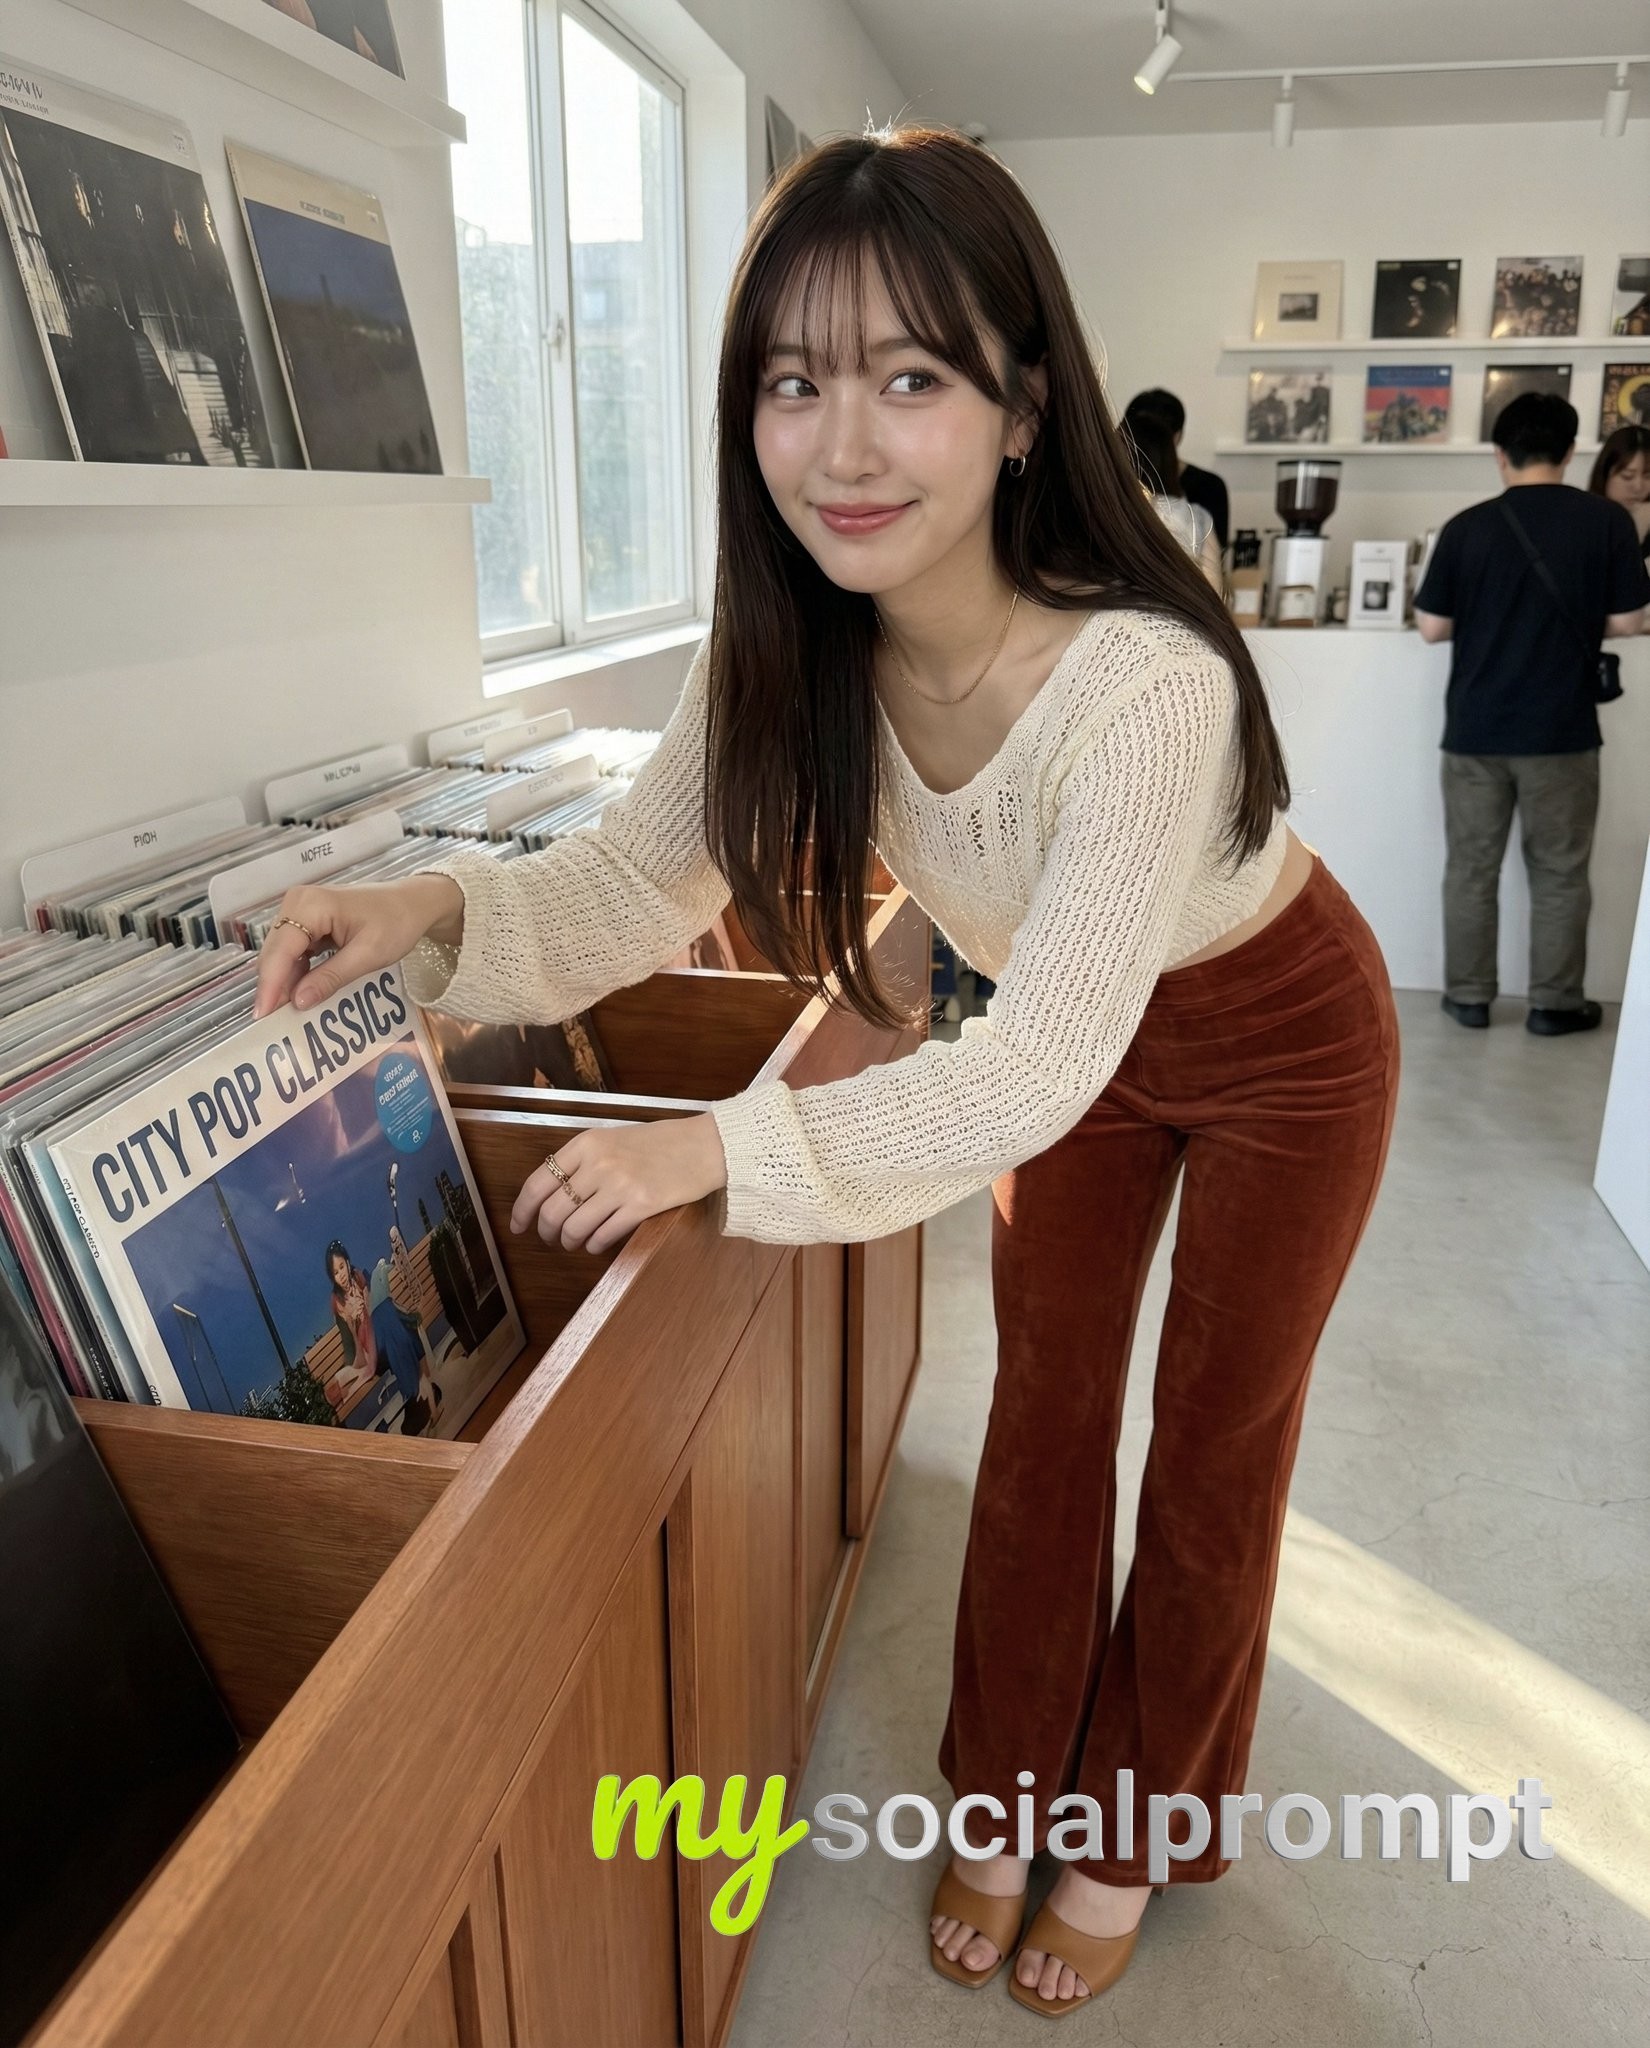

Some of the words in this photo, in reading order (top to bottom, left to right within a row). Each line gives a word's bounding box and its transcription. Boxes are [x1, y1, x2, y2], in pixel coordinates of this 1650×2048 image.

[92, 1109, 191, 1224] CITY
[187, 1062, 262, 1159] POP
[265, 971, 407, 1104] CLASSICS
